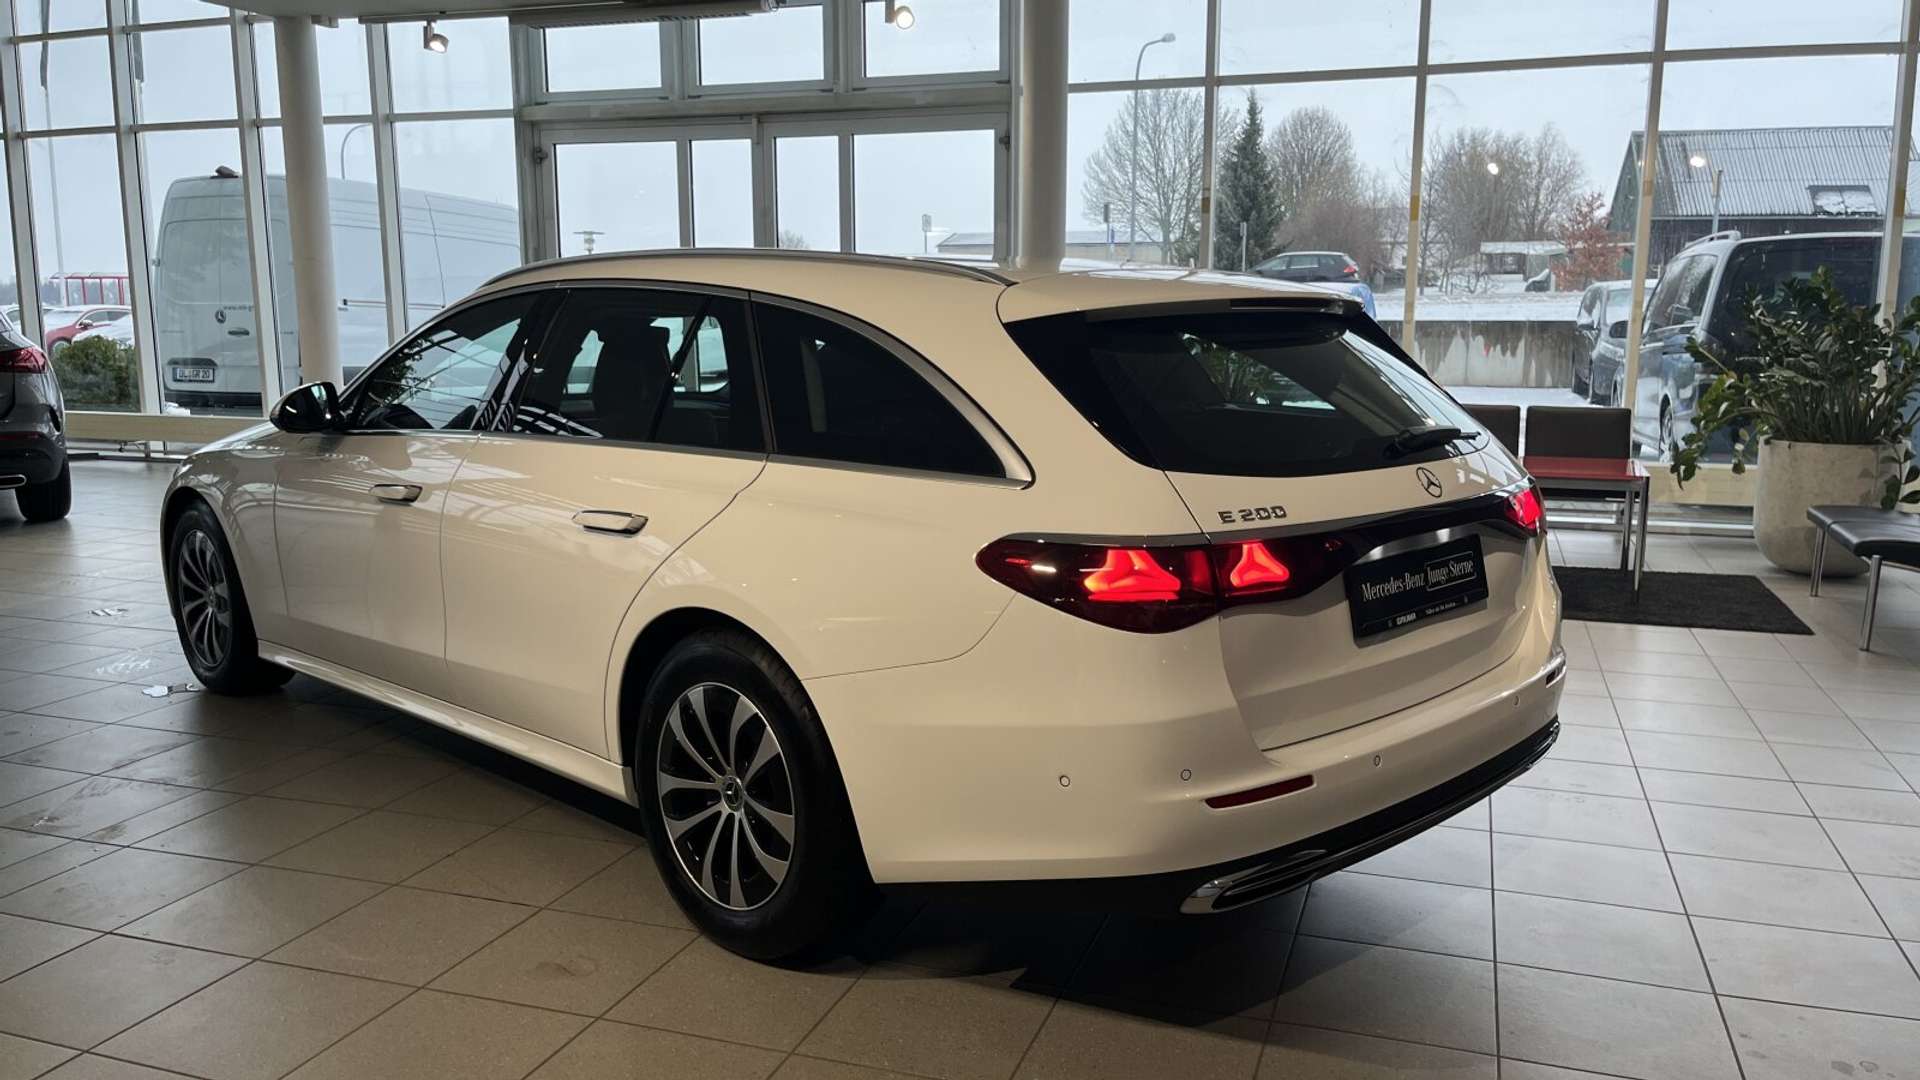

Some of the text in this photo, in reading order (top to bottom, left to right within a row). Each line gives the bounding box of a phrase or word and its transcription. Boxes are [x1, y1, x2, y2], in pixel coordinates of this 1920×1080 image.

[201, 369, 211, 379] 20
[1217, 505, 1287, 524] E 200
[1361, 560, 1474, 602] Mercedes-Benz Junge Sterne
